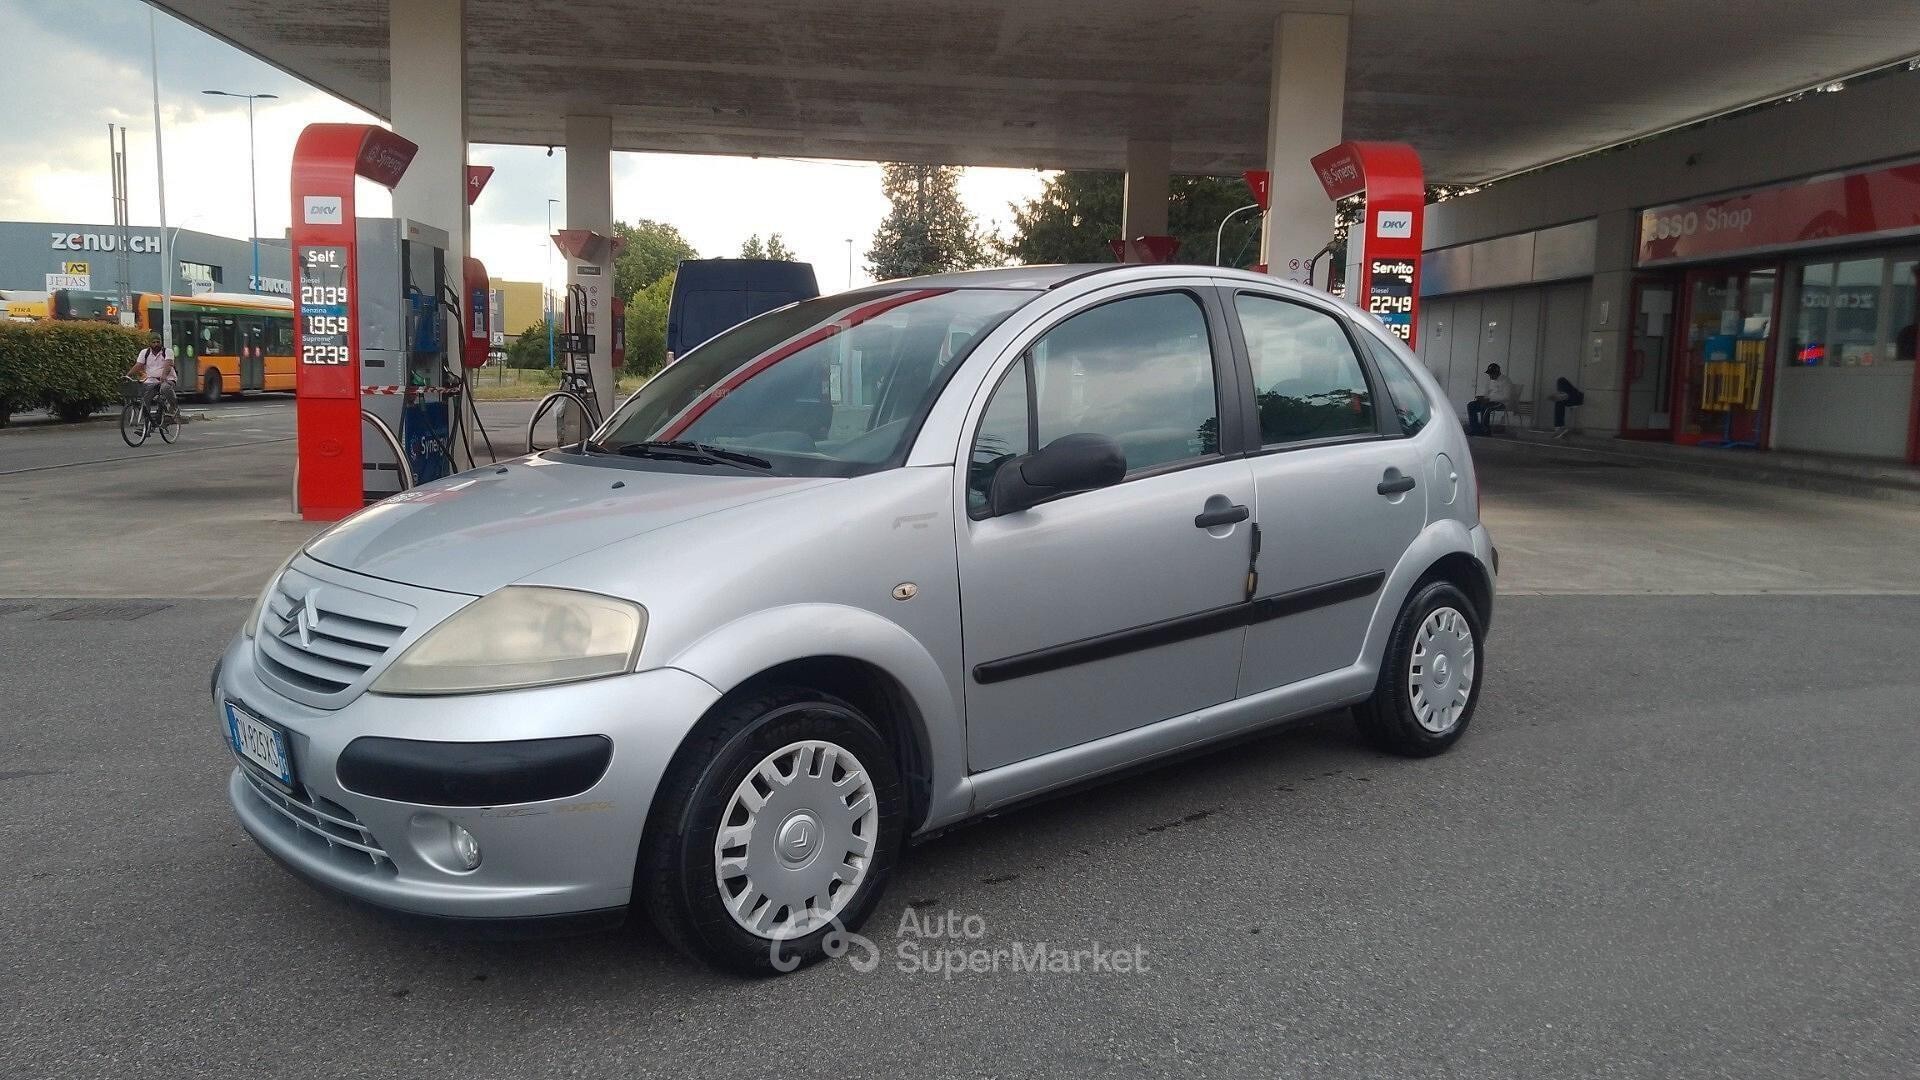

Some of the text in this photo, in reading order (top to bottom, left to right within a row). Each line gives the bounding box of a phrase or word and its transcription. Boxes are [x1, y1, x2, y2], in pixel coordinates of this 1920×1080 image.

[470, 175, 480, 187] 4
[1259, 180, 1265, 193] 1
[310, 206, 336, 215] DKV
[1382, 220, 1407, 229] DKV
[1705, 207, 1752, 233] Shop
[308, 250, 336, 263] Self
[1372, 261, 1414, 275] Servito
[300, 276, 321, 284] Diesel
[301, 306, 328, 315] Benzina
